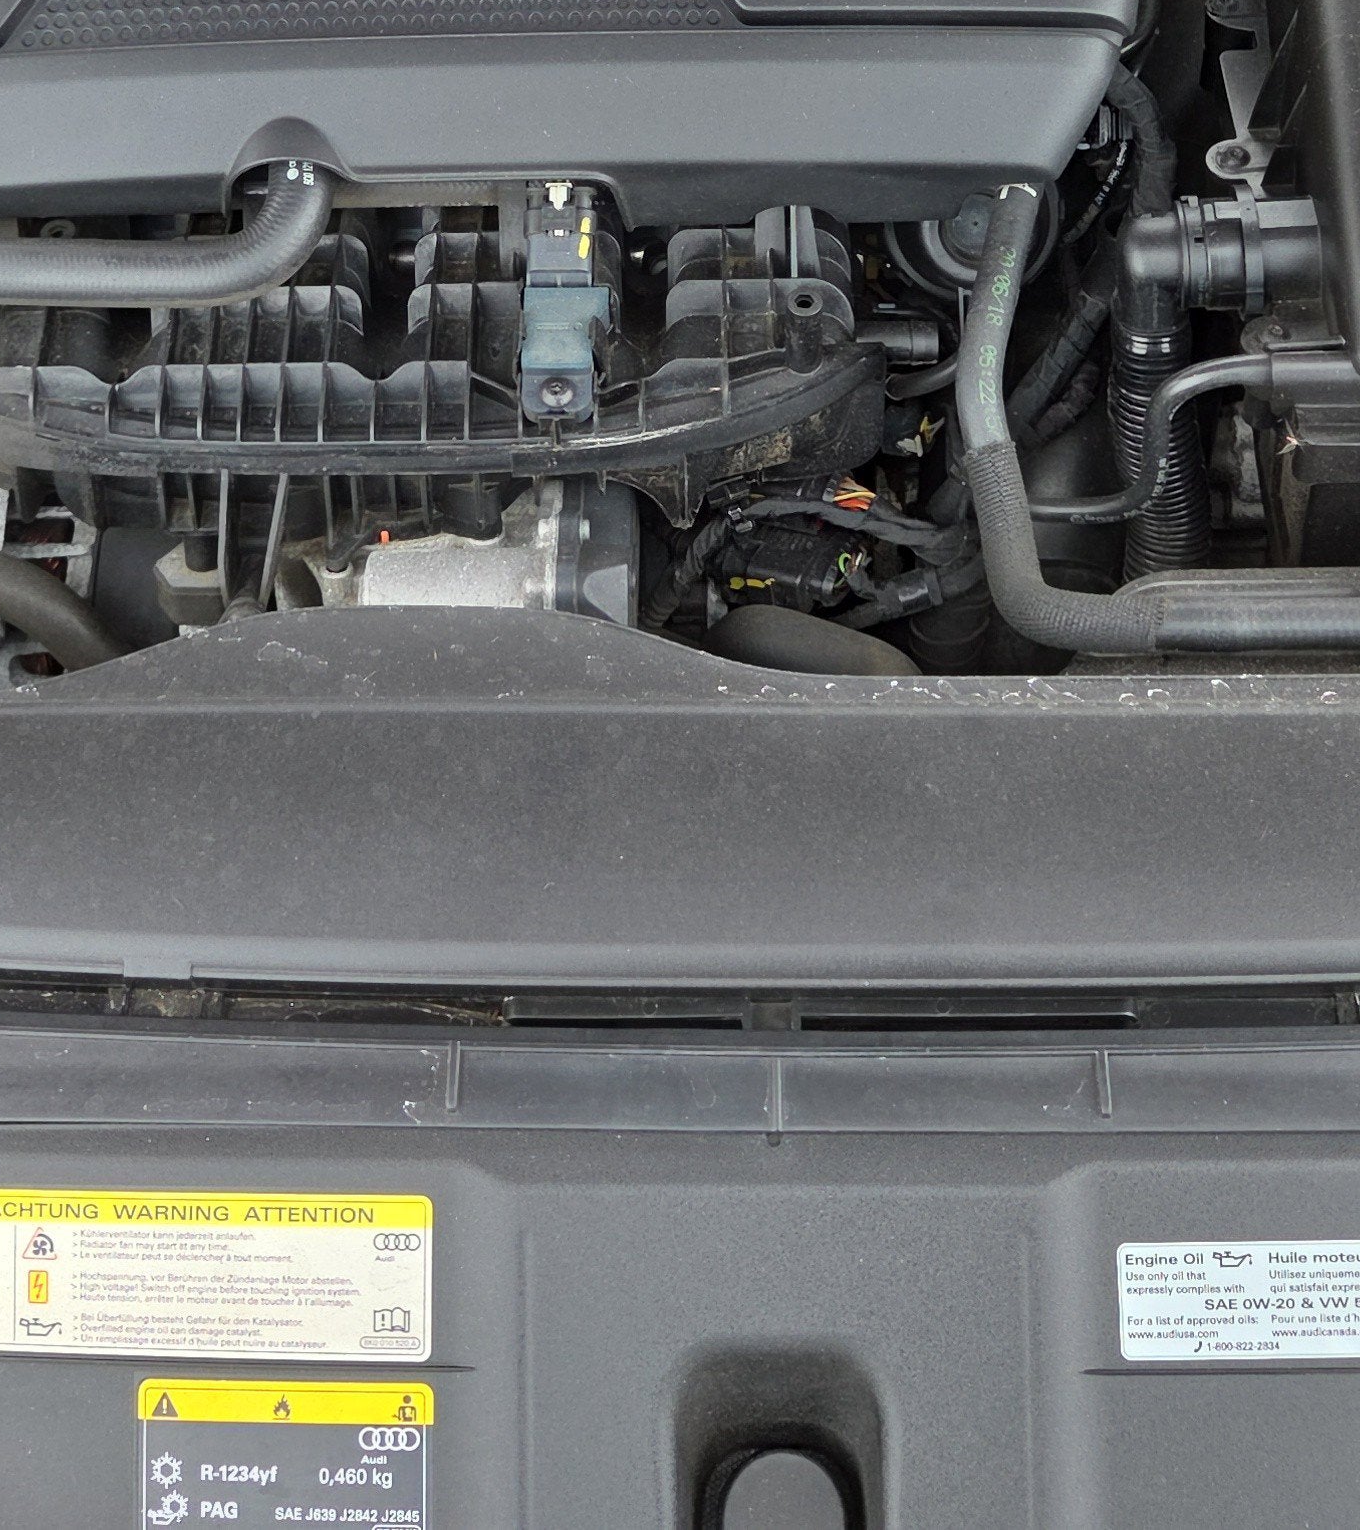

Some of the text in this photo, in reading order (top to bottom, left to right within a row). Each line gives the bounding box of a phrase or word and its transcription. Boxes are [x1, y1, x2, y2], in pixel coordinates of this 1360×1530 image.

[113, 1204, 229, 1222] WARNING
[244, 1206, 374, 1223] ATTENTION
[120, 1241, 133, 1249] fan
[136, 1243, 154, 1251] may
[157, 1242, 176, 1250] start
[190, 1244, 205, 1252] any
[142, 1253, 161, 1261] peut
[1126, 1254, 1178, 1267] Engine
[1184, 1253, 1203, 1264] Oil
[1269, 1252, 1307, 1263] Huile
[1126, 1271, 1206, 1282] Use only oil that
[1269, 1270, 1306, 1279] Utilisez
[283, 1277, 309, 1285] Motor
[81, 1283, 100, 1291] High
[141, 1284, 170, 1292] Switch
[188, 1286, 217, 1294] engine
[220, 1286, 247, 1294] before
[251, 1287, 288, 1296] touching
[1127, 1284, 1245, 1295] expressly complies with
[1270, 1283, 1286, 1293] qui
[1290, 1282, 1329, 1292] satisfait
[1205, 1299, 1237, 1310] SAE
[1243, 1298, 1296, 1310] 0W-20
[1301, 1297, 1313, 1308] &
[1319, 1297, 1349, 1308] VW
[186, 1316, 215, 1324] Gefahr
[1128, 1317, 1144, 1325] For
[1156, 1316, 1171, 1325] list
[1174, 1316, 1184, 1325] of
[1187, 1315, 1234, 1326] approved
[1238, 1315, 1258, 1324] oils:
[1271, 1315, 1295, 1324] Pour
[1298, 1315, 1316, 1323] une
[1320, 1313, 1340, 1322] liste
[126, 1326, 155, 1334] engine
[189, 1327, 224, 1336] damage
[1128, 1330, 1218, 1338] www.audiusa.com
[360, 1455, 387, 1464] Audi
[200, 1464, 393, 1489] R-1234yf 0,460 kg
[200, 1501, 420, 1522] PAG SAE J639 J2842 J2845
